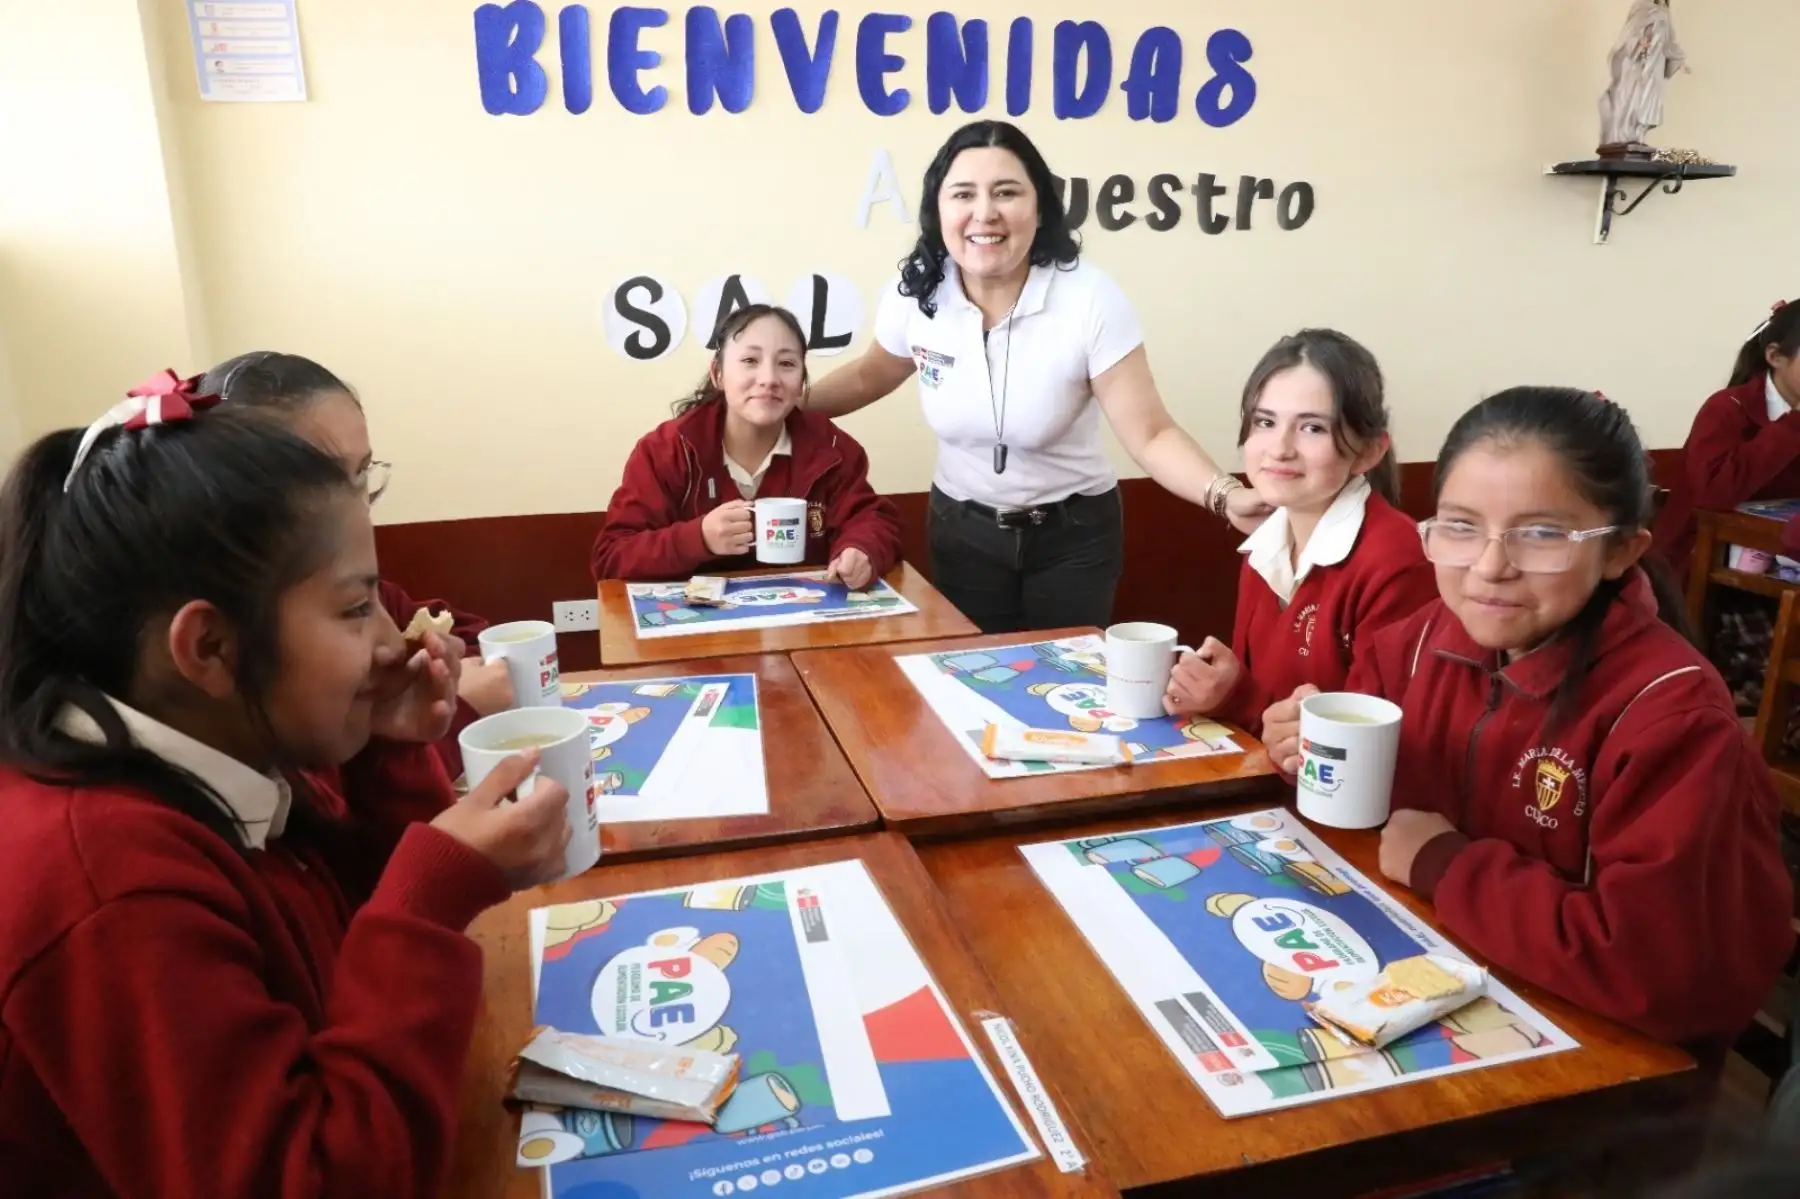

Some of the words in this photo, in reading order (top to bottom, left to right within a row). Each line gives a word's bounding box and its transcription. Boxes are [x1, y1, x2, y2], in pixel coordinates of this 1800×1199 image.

[474, 0, 1257, 128] BIENVENIDAS
[854, 147, 912, 229] A
[1051, 172, 1315, 235] uestro
[766, 529, 795, 541] PAE
[1252, 912, 1340, 972] PAE
[647, 957, 695, 1028] PAE
[763, 1152, 782, 1164] en
[784, 1143, 825, 1159] redes
[826, 1128, 885, 1150] sociales!
[1033, 1093, 1065, 1144] RODRIGUEZ
